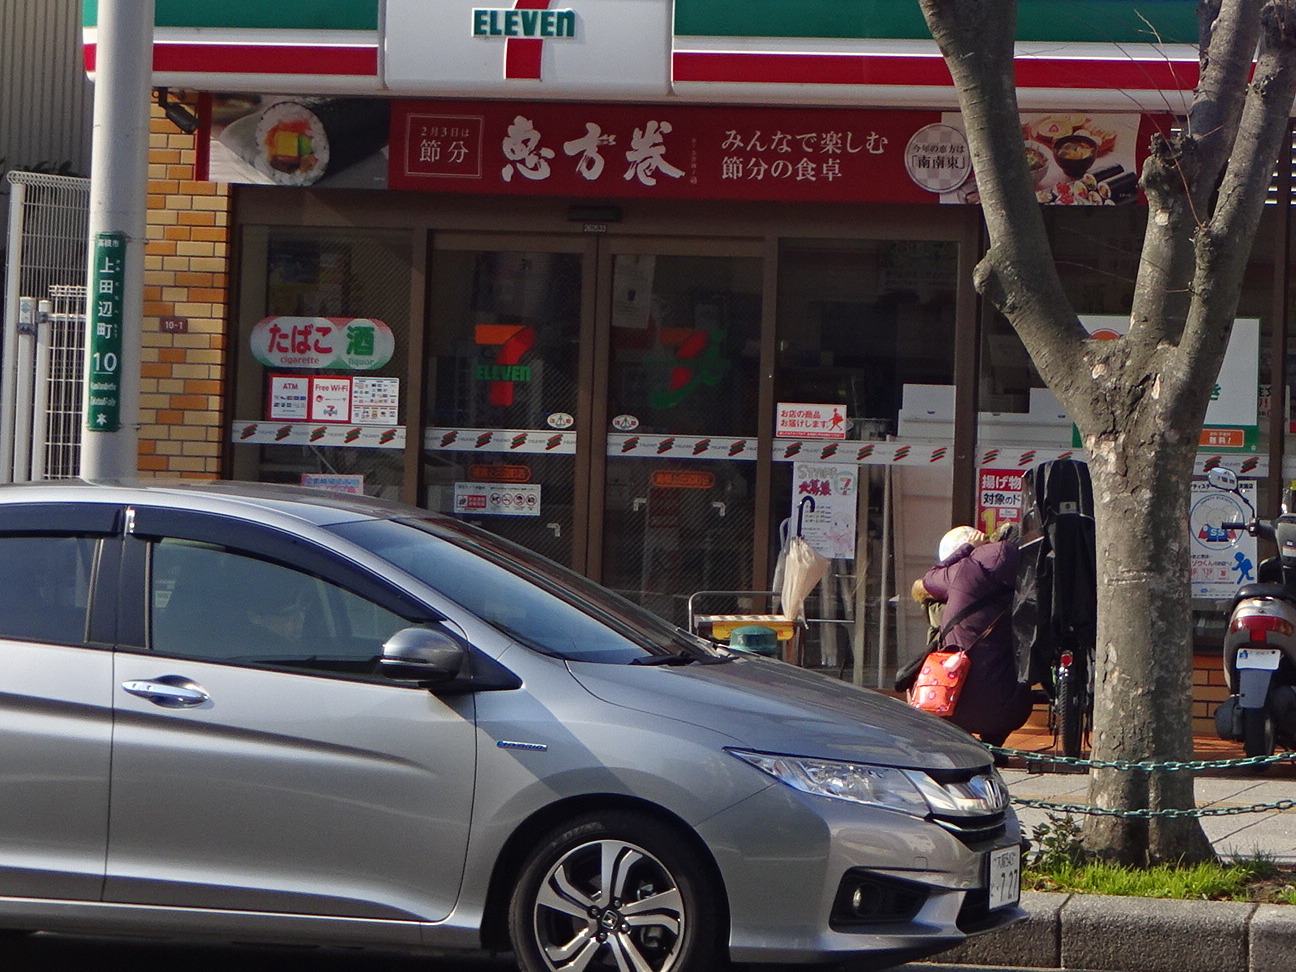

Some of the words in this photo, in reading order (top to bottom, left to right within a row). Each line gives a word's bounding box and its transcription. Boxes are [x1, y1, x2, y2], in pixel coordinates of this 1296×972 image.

[420, 126, 470, 138] 2月3日は
[419, 139, 469, 163] 節分
[501, 115, 686, 186] 恵方巻
[721, 130, 889, 155] みんなで楽しむ
[721, 156, 843, 182] 節分の食卓
[96, 256, 115, 340] 上田辺町
[165, 321, 183, 330] 10-1
[267, 323, 333, 355] たばこ
[346, 325, 376, 356] 酒
[93, 352, 118, 372] 10
[280, 355, 320, 365] cigarette
[282, 382, 299, 391] ATM
[315, 383, 330, 392] Free
[331, 384, 349, 392] Wi-Fi
[781, 410, 821, 419] お店の商品
[981, 474, 1022, 490] 揚げ物
